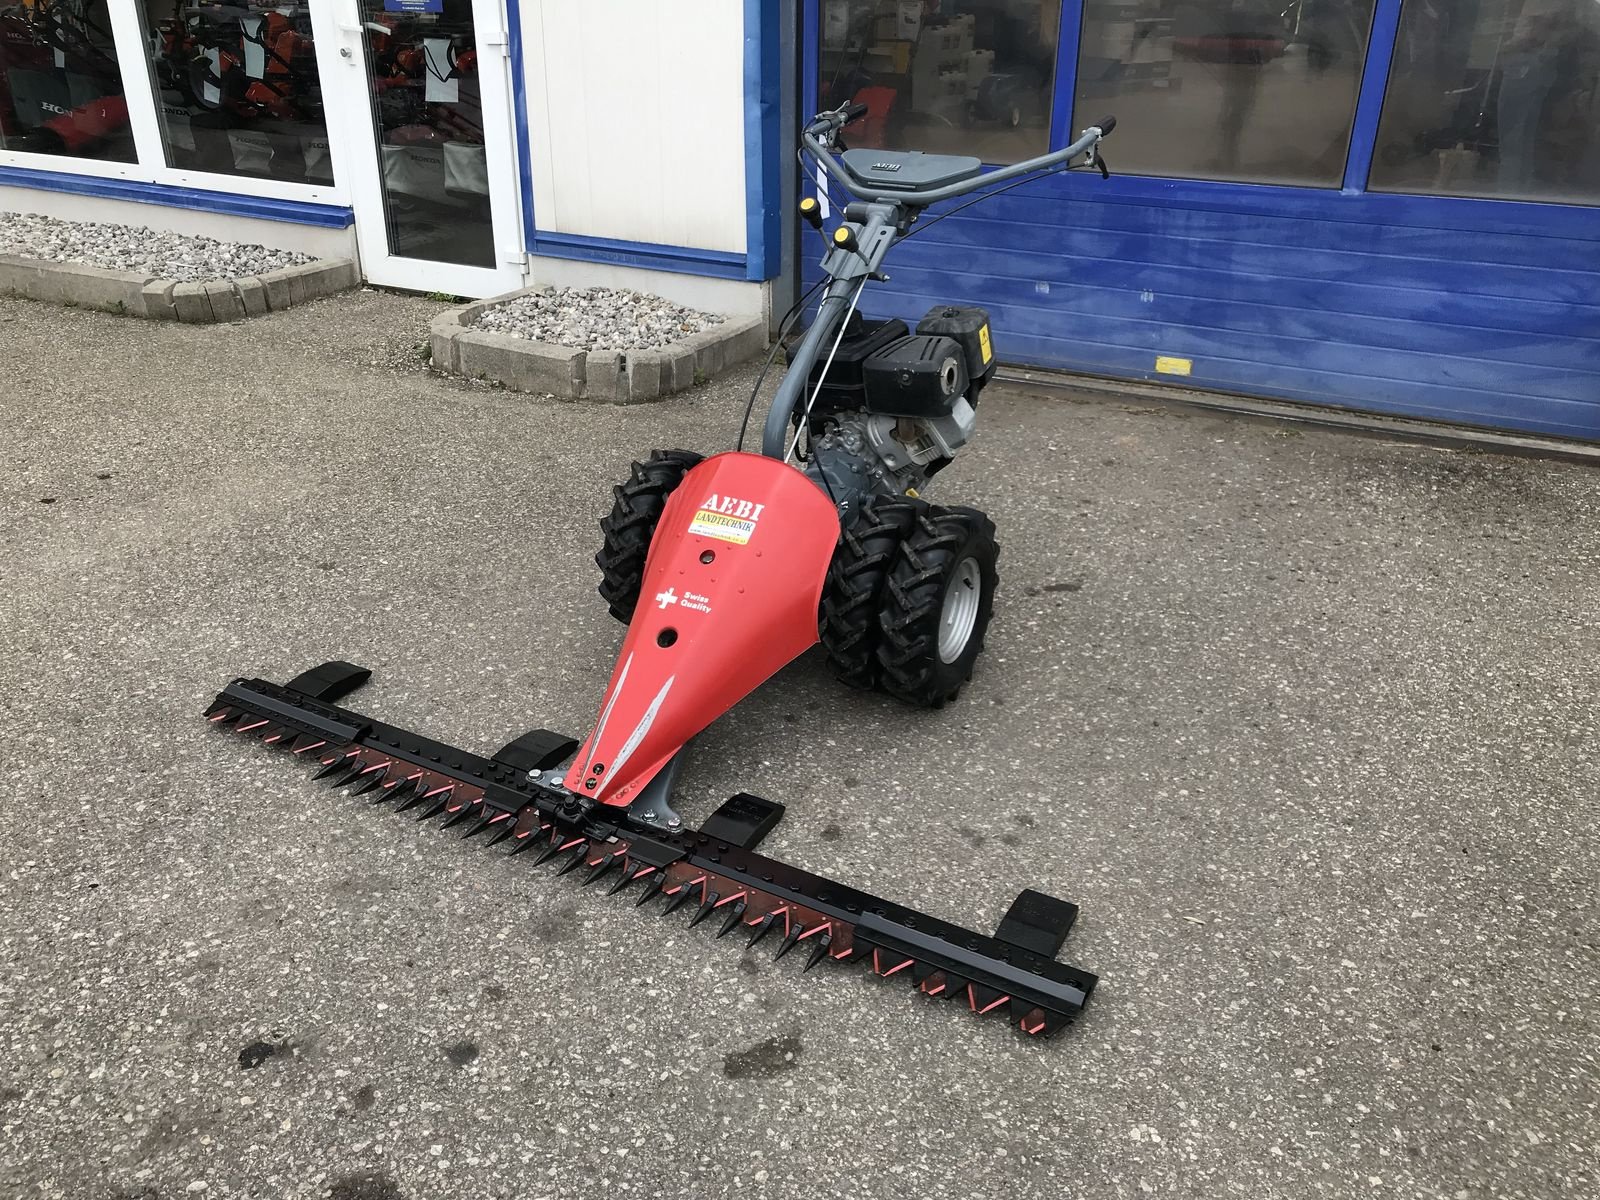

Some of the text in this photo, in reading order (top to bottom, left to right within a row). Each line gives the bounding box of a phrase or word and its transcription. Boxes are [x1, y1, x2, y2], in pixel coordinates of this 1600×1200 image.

[700, 493, 765, 521] AEBI
[695, 512, 754, 532] LANDTECHNIK
[683, 591, 709, 603] Swiss
[680, 599, 712, 614] Quality
